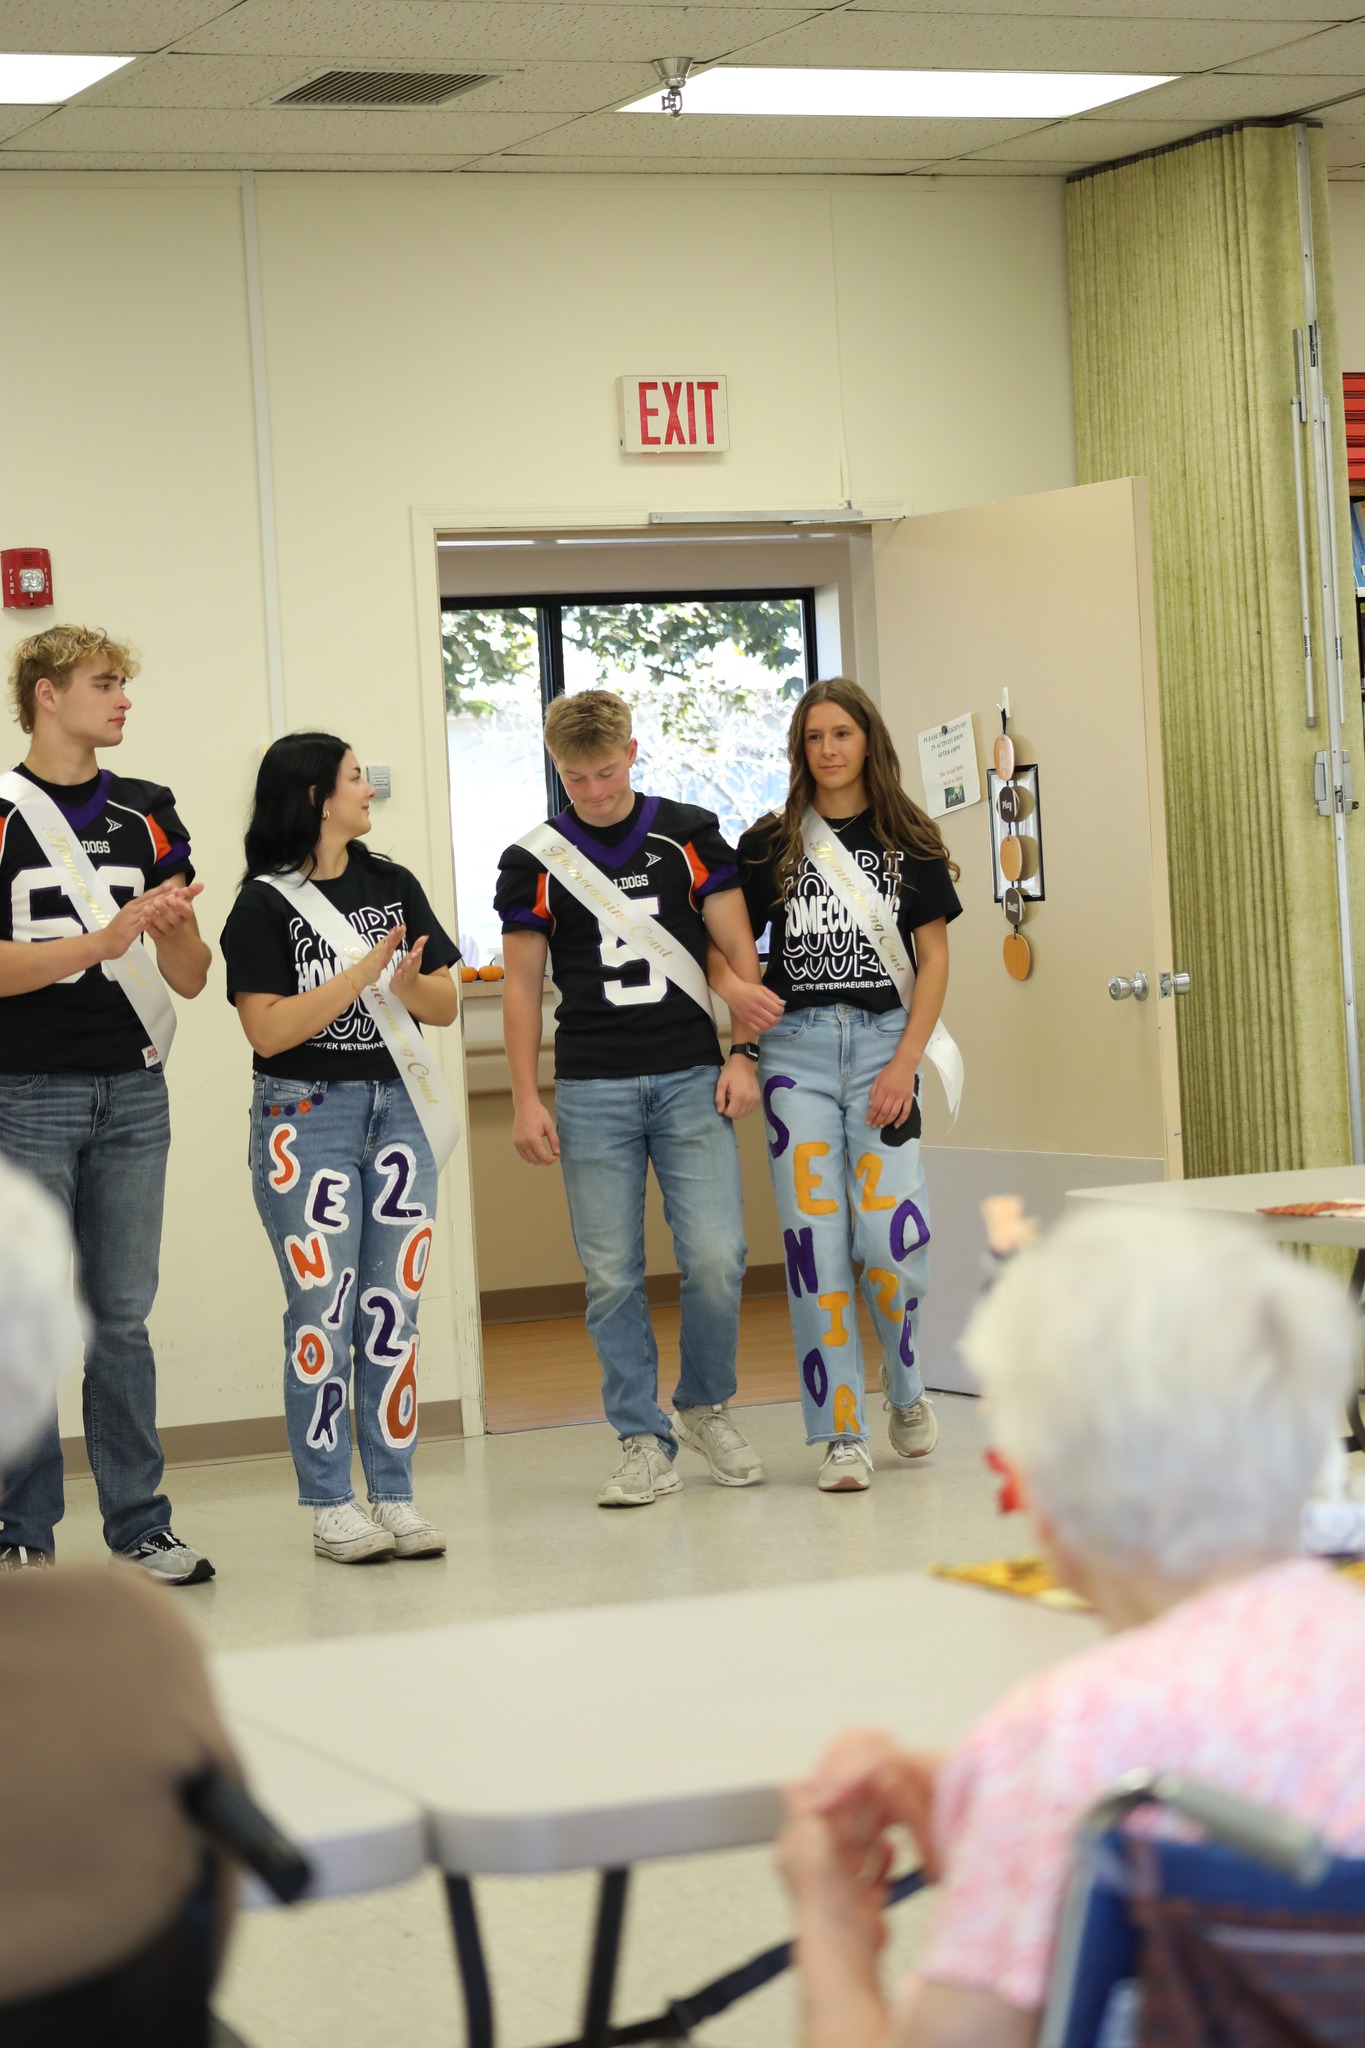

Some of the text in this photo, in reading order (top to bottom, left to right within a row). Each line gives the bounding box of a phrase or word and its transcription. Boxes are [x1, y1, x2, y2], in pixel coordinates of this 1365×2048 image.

[638, 381, 718, 445] EXIT
[1001, 799, 1012, 811] Play
[82, 840, 111, 854] DOGS
[613, 874, 649, 890] LDOGS
[628, 925, 673, 958] Court
[879, 935, 906, 973] Court
[875, 979, 892, 988] 2025
